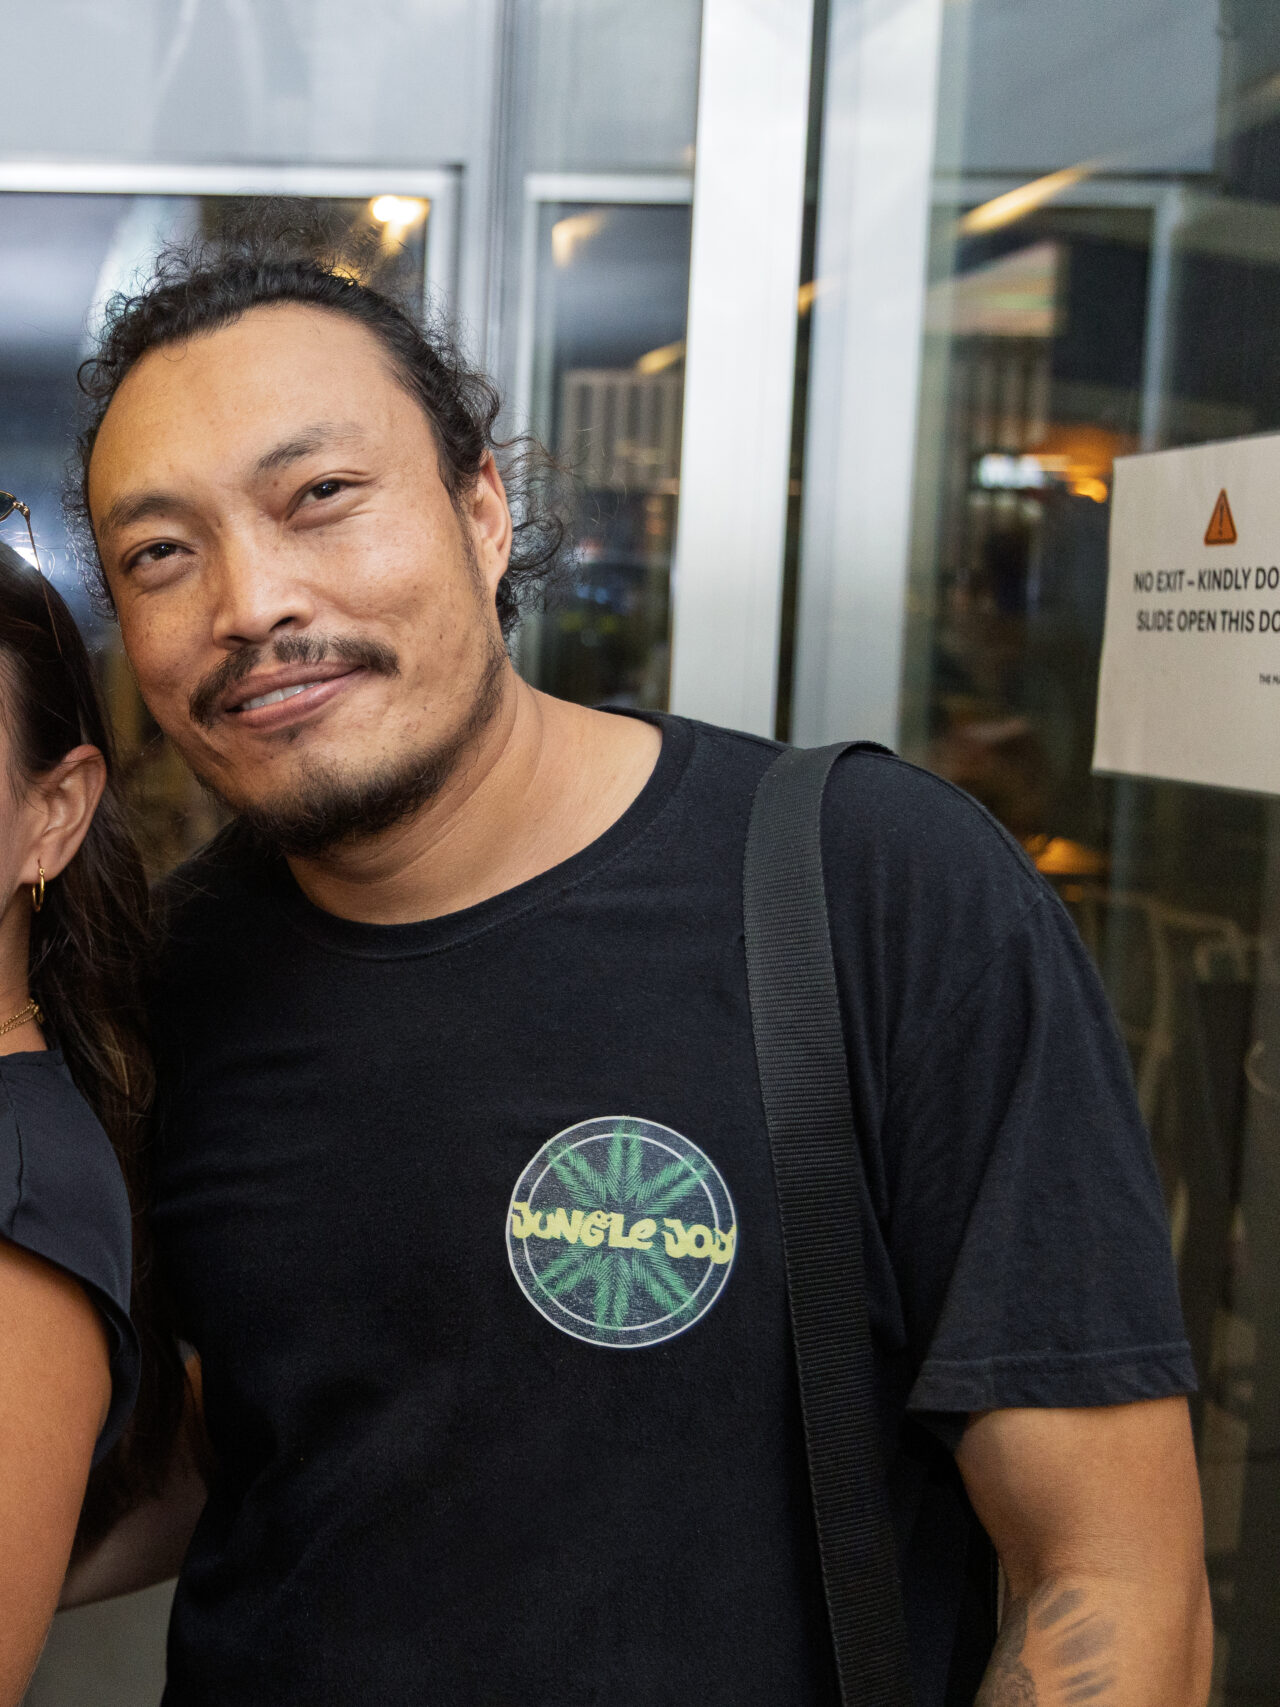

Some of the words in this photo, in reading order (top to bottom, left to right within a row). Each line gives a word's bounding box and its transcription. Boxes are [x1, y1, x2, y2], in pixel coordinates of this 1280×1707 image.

[1133, 570, 1154, 592] NO
[1156, 569, 1185, 592] EXIT
[1198, 567, 1252, 591] KINDLY
[1137, 609, 1174, 632] SLIDE
[1177, 609, 1217, 632] OPEN
[1220, 609, 1255, 633] THIS
[663, 1217, 737, 1265] JOY
